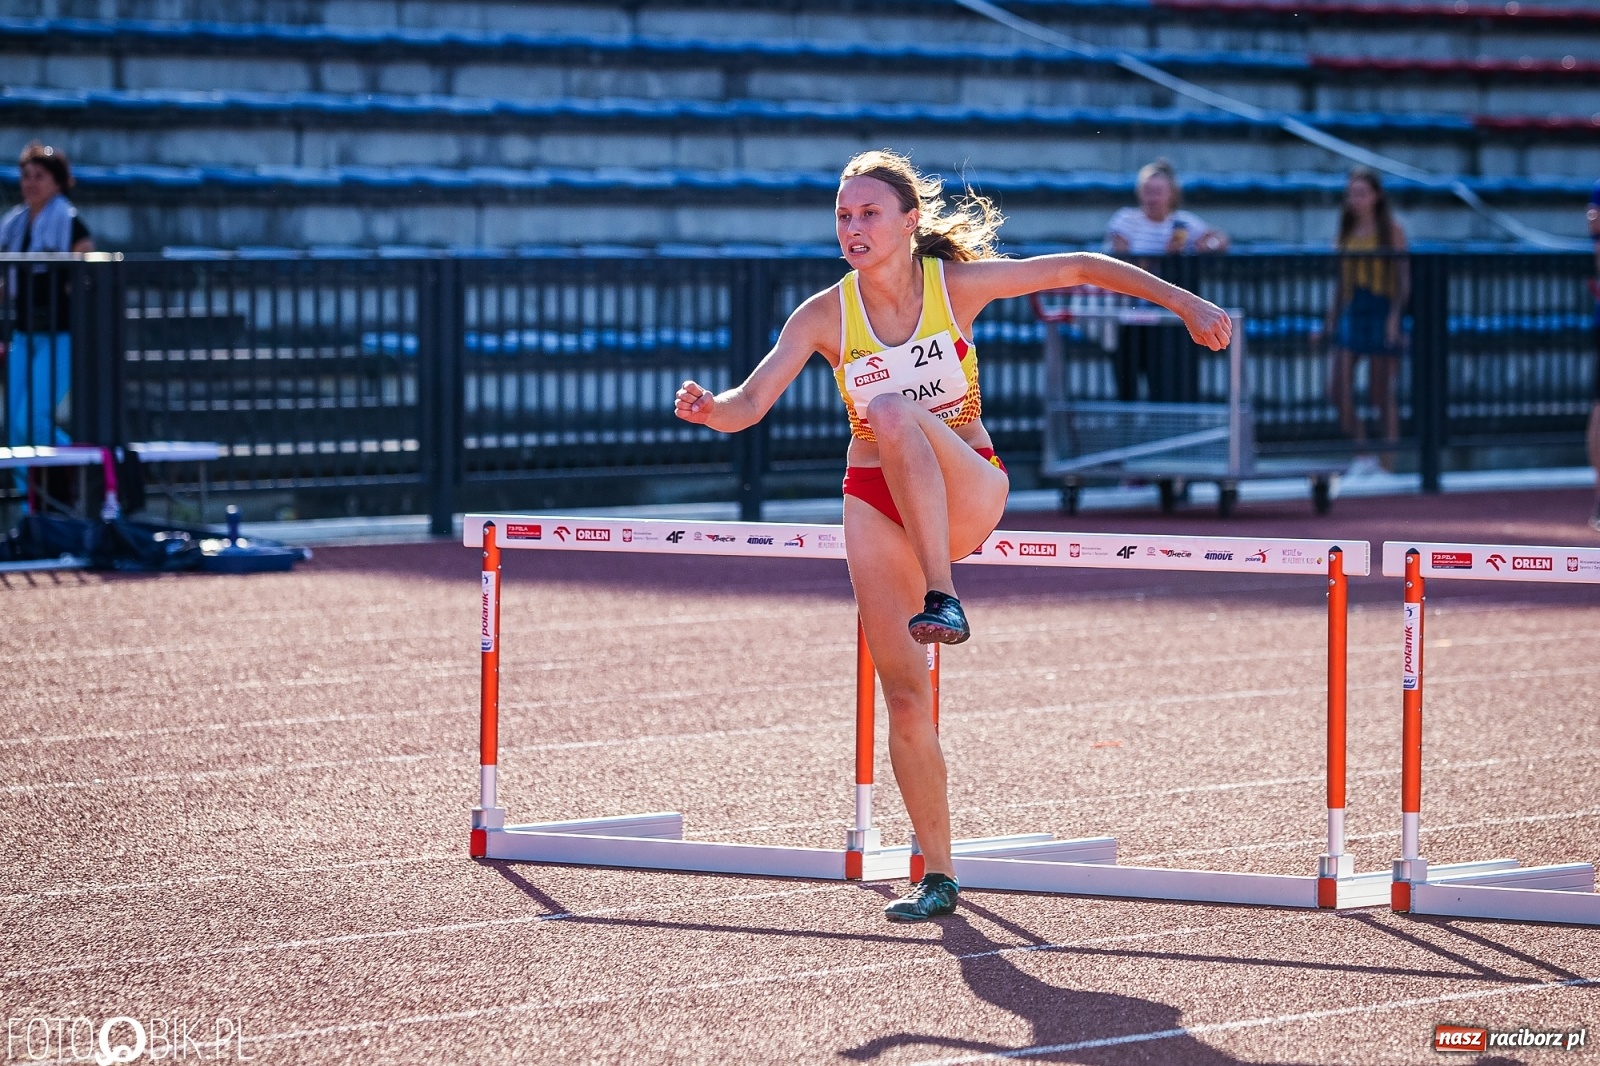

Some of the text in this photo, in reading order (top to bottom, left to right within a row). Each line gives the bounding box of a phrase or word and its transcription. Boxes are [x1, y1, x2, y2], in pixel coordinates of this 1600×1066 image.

[910, 340, 943, 368] 24
[856, 370, 888, 385] ORLEN
[577, 530, 609, 540] ORLEN
[666, 530, 686, 543] 4F
[746, 537, 774, 545] 4MOVE
[1021, 544, 1055, 555] ORLEN
[1116, 545, 1138, 559] 4F
[1204, 552, 1234, 561] 4MOVE
[1514, 558, 1551, 569] ORLEN
[481, 592, 490, 637] polanik
[1404, 625, 1414, 674] polanik
